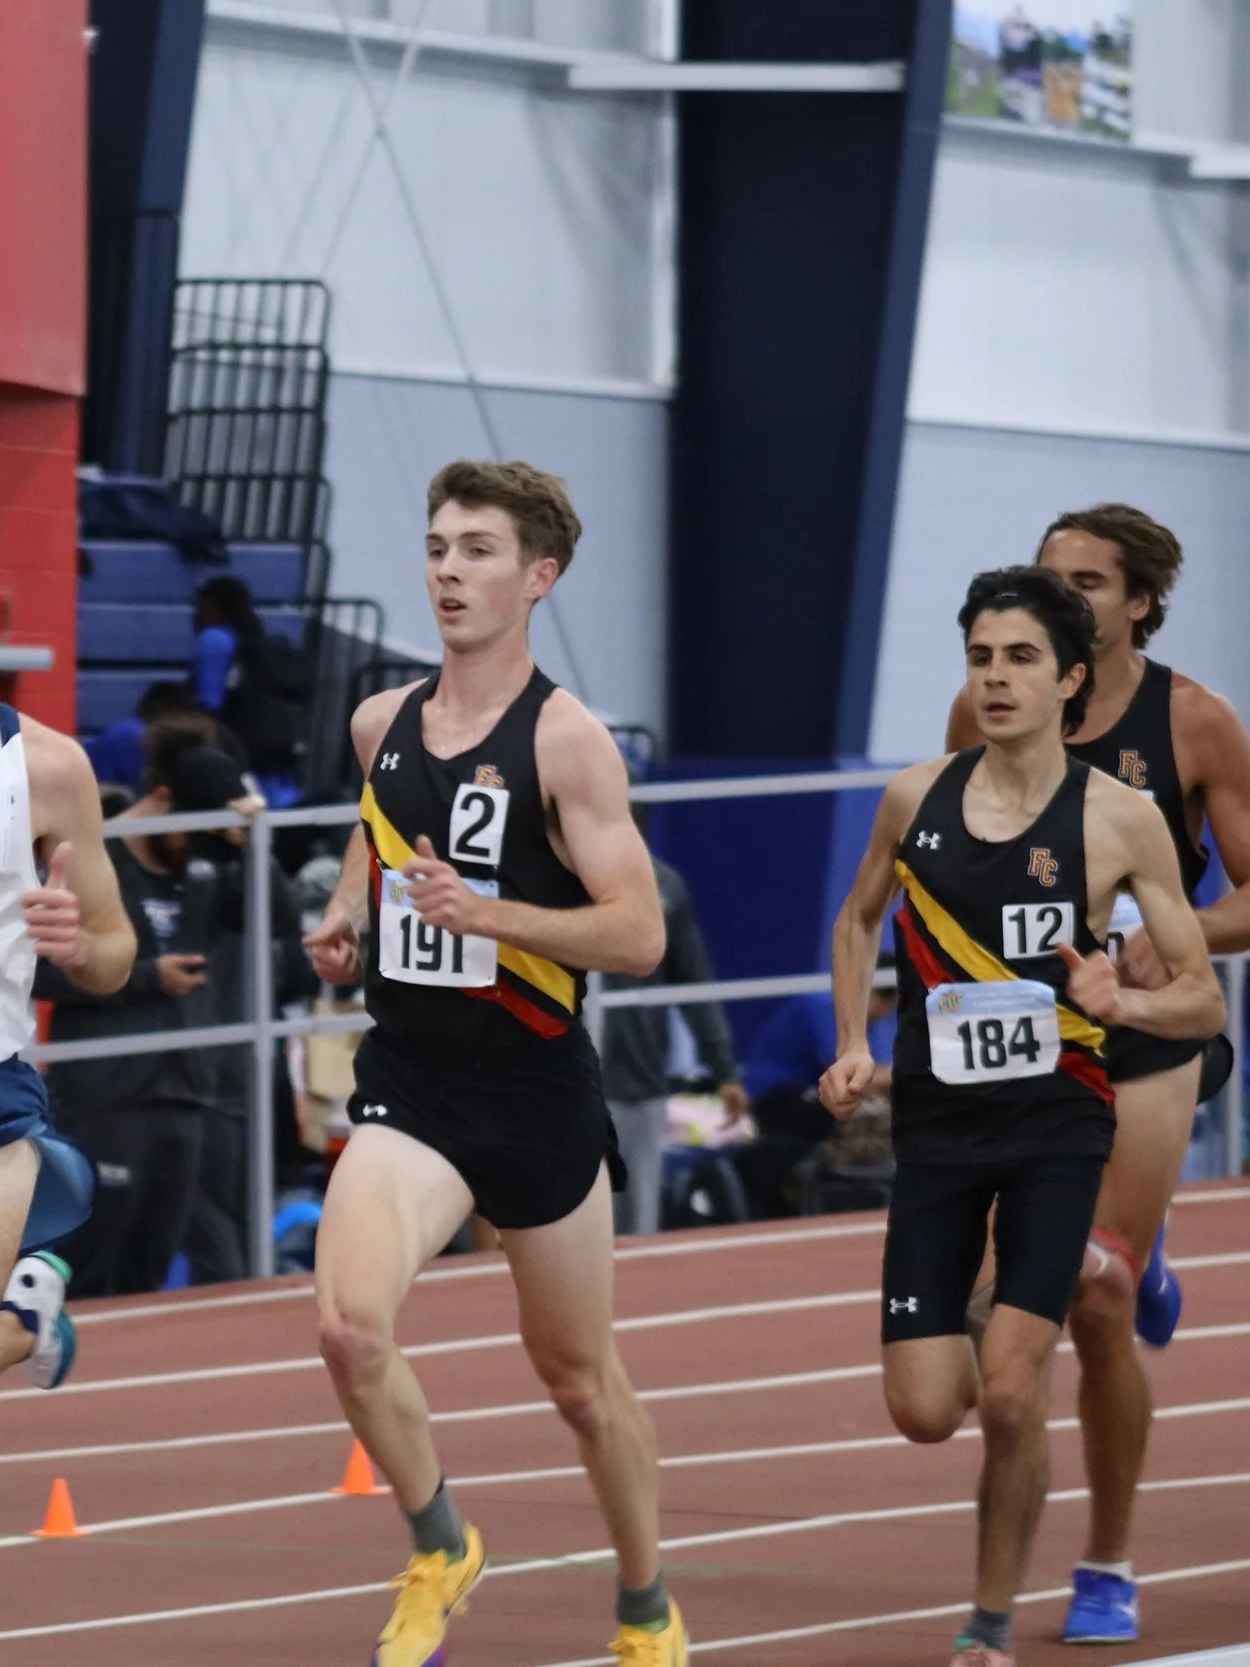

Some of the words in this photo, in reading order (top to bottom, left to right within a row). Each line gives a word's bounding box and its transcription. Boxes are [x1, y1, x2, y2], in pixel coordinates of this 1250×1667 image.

[1118, 750, 1146, 788] FC
[455, 791, 495, 858] 2
[1027, 848, 1058, 887] FC
[400, 914, 463, 973] 191
[1008, 906, 1062, 954] 12
[957, 1016, 1040, 1070] 184
